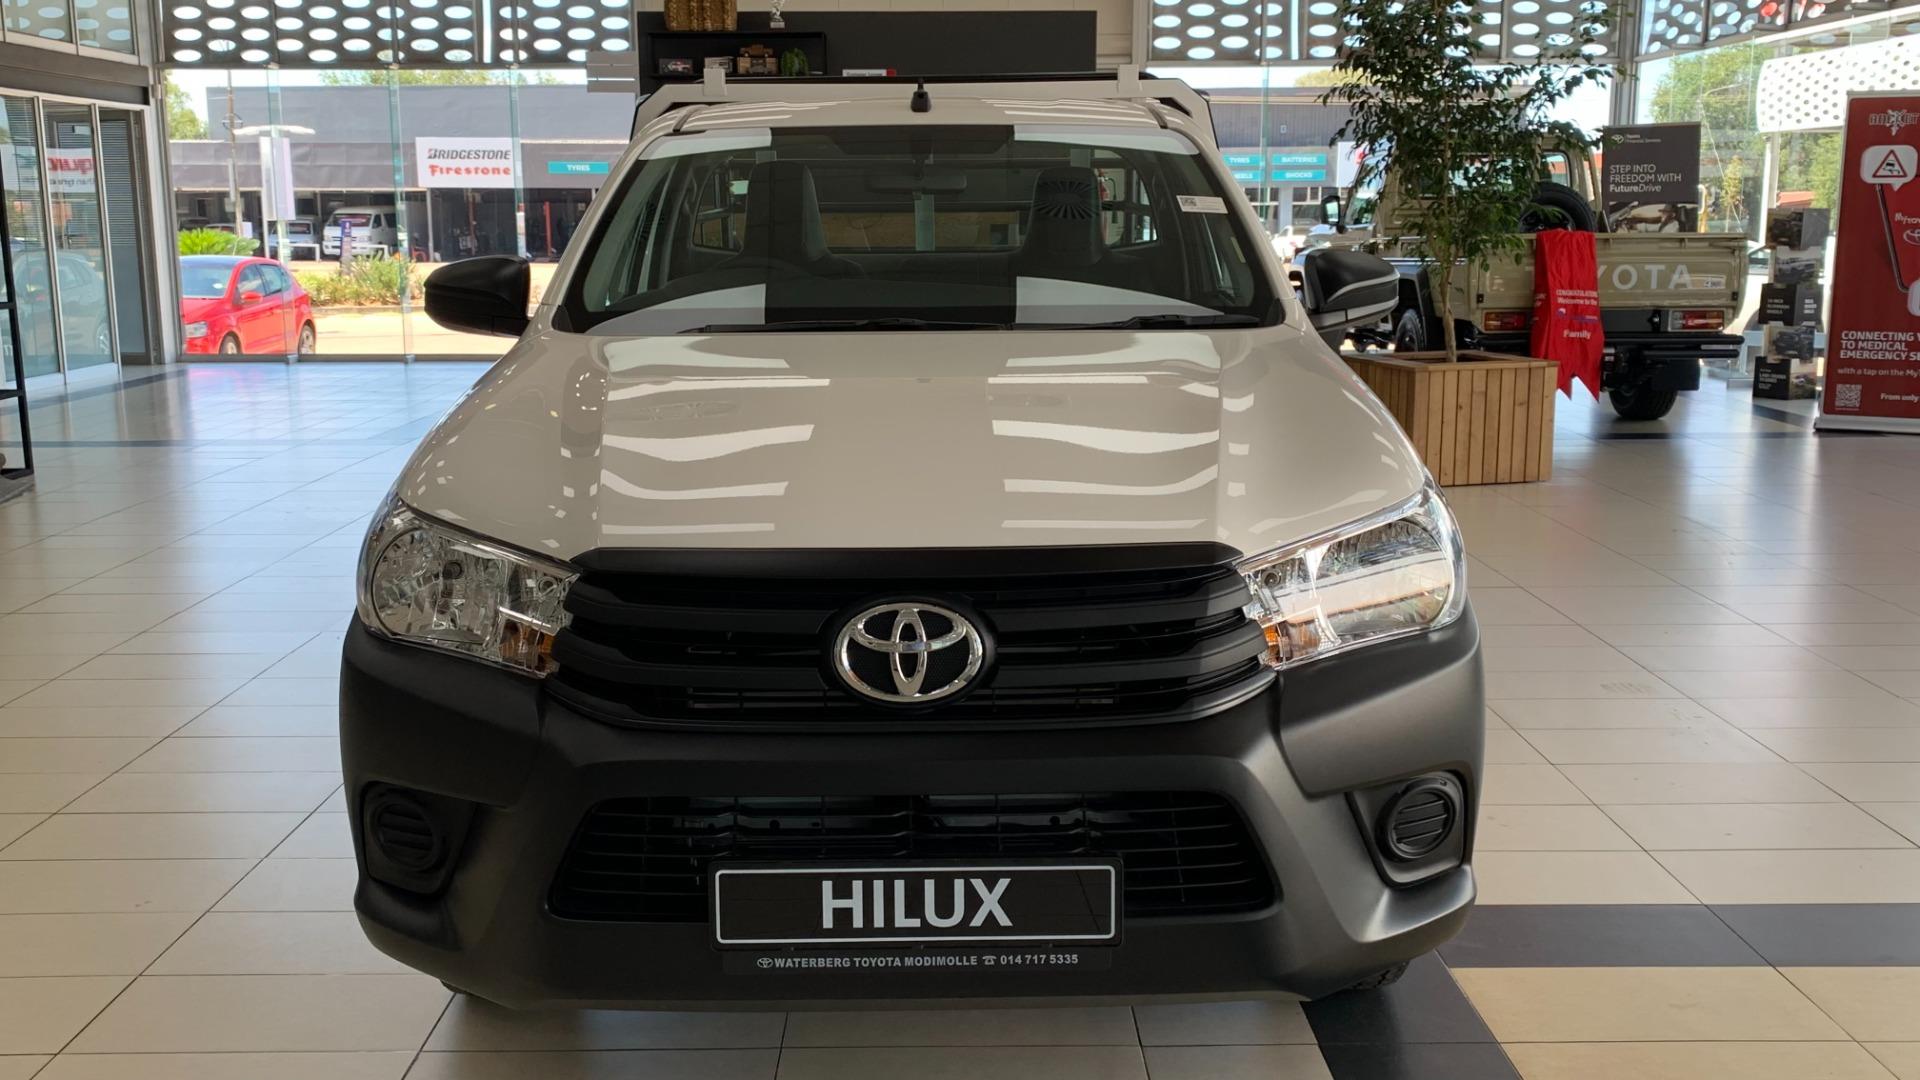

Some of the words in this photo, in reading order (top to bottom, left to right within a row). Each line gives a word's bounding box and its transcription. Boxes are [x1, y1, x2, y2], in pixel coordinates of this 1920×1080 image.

[427, 148, 511, 159] BRIDGESTONE
[428, 164, 511, 176] Firestone
[1609, 164, 1632, 174] STEP
[1632, 163, 1656, 173] INTO
[1609, 174, 1655, 183] FREEDOM
[1657, 173, 1682, 182] WITH
[1609, 184, 1662, 193] FutureDrive
[1563, 330, 1592, 340] Family
[1841, 331, 1914, 341] CONNECTING
[1840, 340, 1856, 349] TO
[1857, 341, 1908, 351] MEDICAL
[1839, 350, 1907, 361] EMERGENCY
[1837, 367, 1856, 375] with
[1863, 368, 1877, 376] tap
[1901, 394, 1920, 403] only
[821, 877, 1014, 929] HILUX
[774, 957, 851, 969] WATERBERG
[853, 957, 902, 968] TOYOTA
[904, 955, 978, 967] MODIMOLLE
[1000, 954, 1022, 966] 014
[1025, 954, 1047, 965] 717
[1049, 953, 1079, 965] 5335
